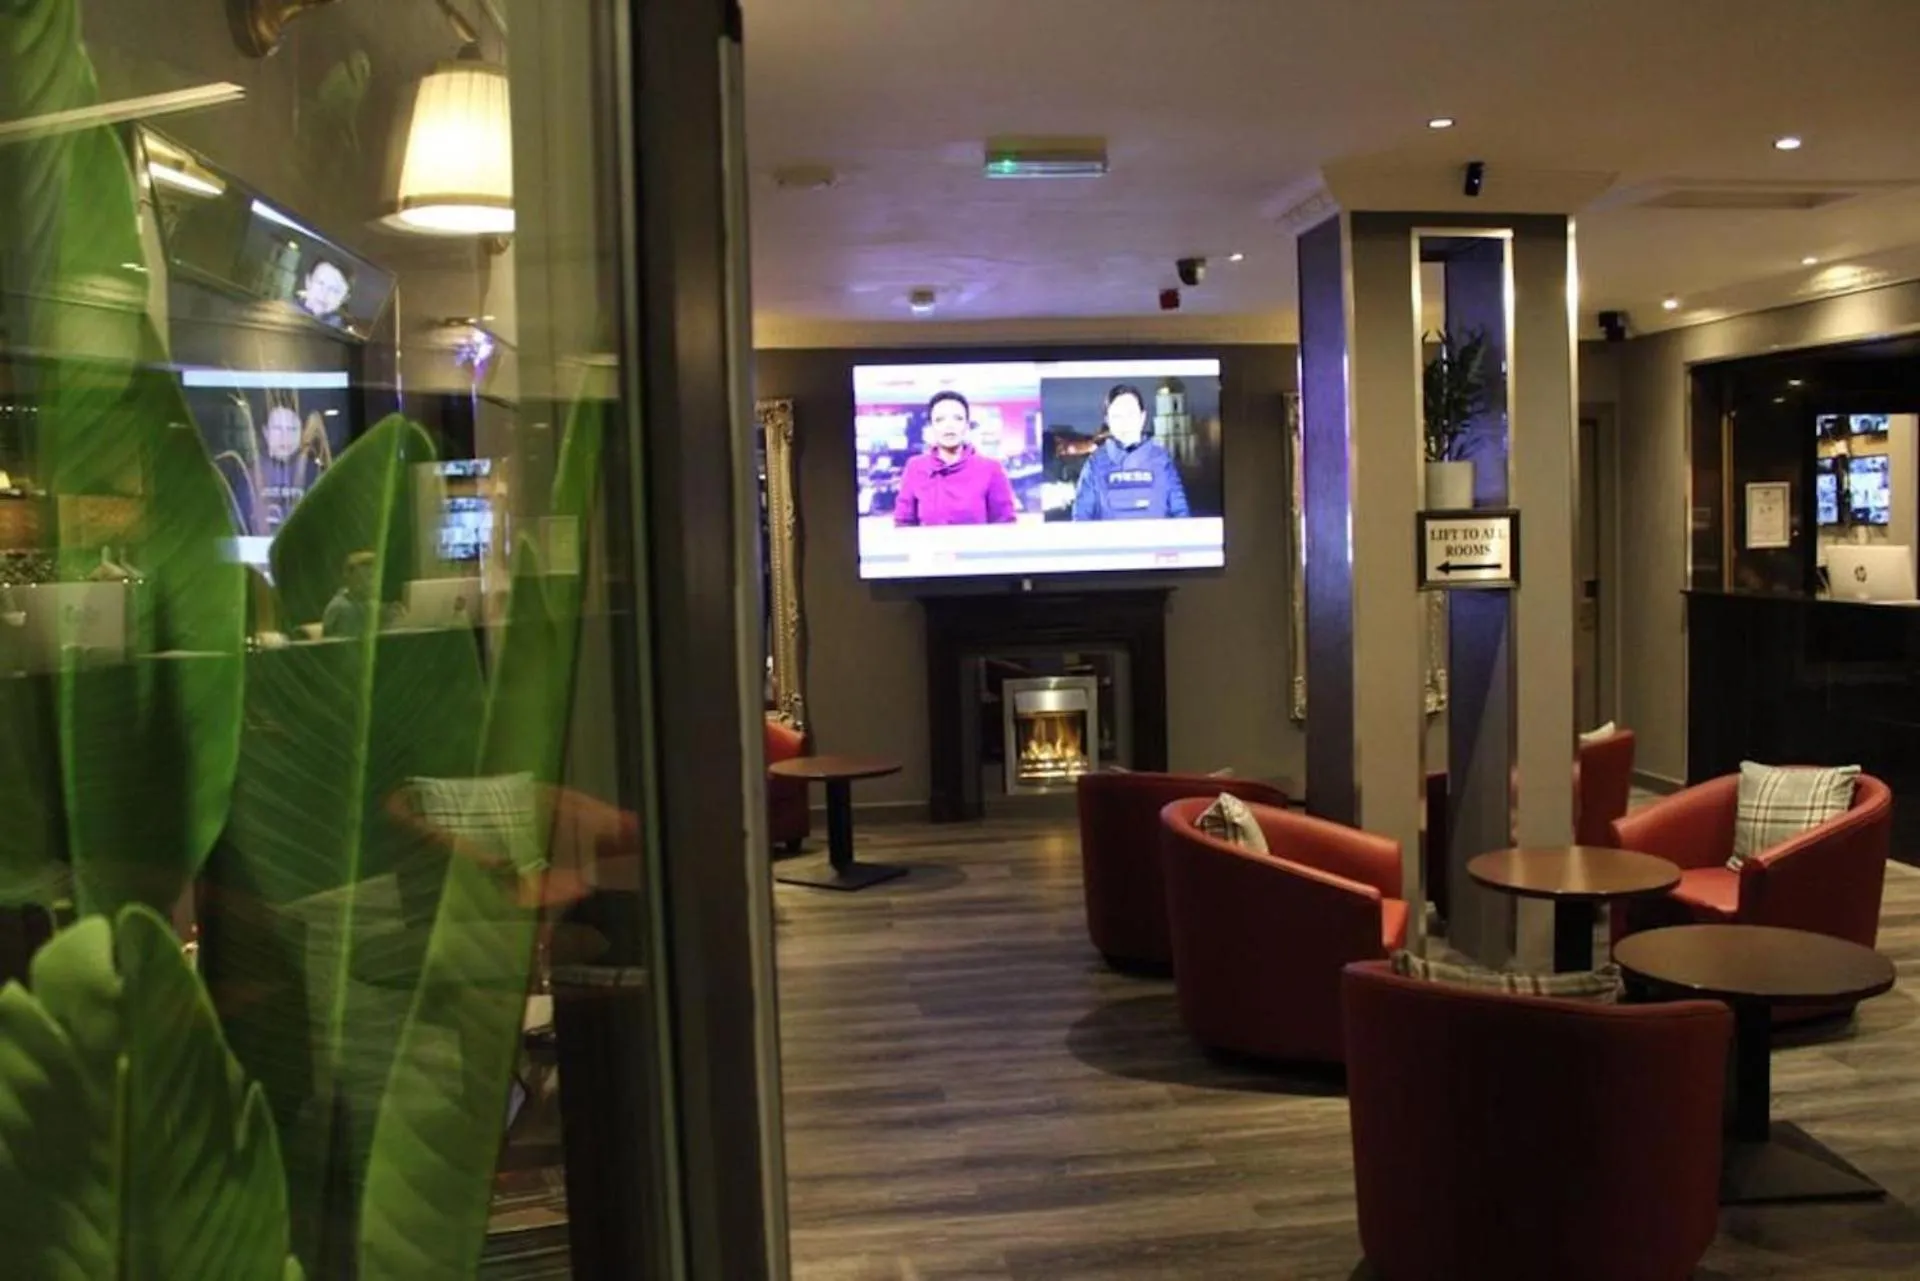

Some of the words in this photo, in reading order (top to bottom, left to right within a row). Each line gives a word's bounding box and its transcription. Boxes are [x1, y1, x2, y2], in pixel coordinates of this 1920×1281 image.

[1430, 528, 1458, 541] LIFT
[1462, 528, 1480, 541] TO
[1445, 544, 1492, 557] ROOMS
